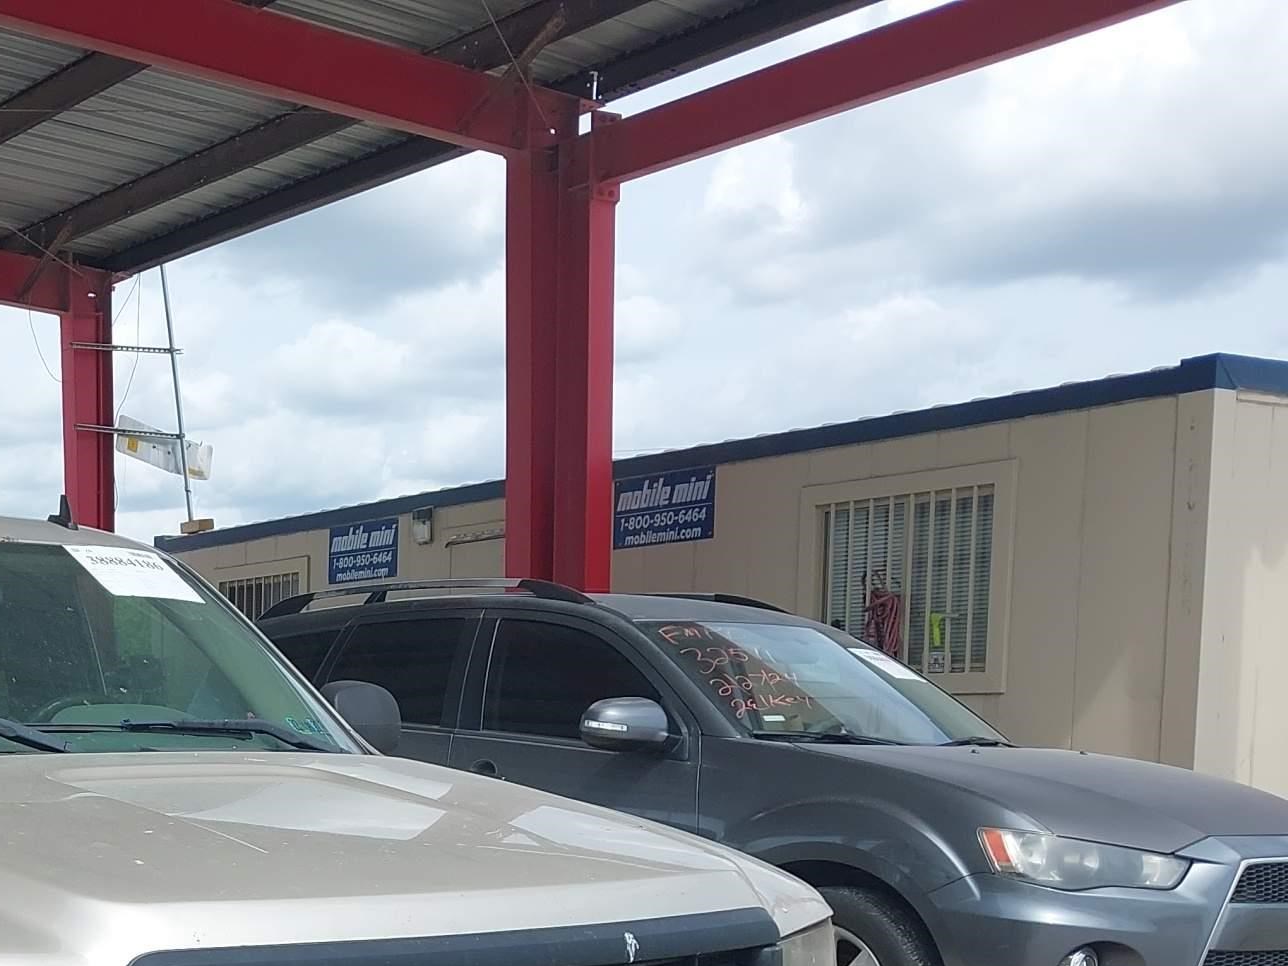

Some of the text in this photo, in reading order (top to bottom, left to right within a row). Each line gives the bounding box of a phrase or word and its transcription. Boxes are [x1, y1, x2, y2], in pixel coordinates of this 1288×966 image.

[617, 474, 711, 511] mobile mini
[620, 507, 707, 532] 1-800-950-6464
[331, 523, 397, 552] mobile mini
[624, 526, 702, 546] mobilemini.com
[86, 555, 165, 571] 38884186
[333, 550, 393, 569] 1-800-950-6464
[335, 567, 389, 582] mobilemini.com
